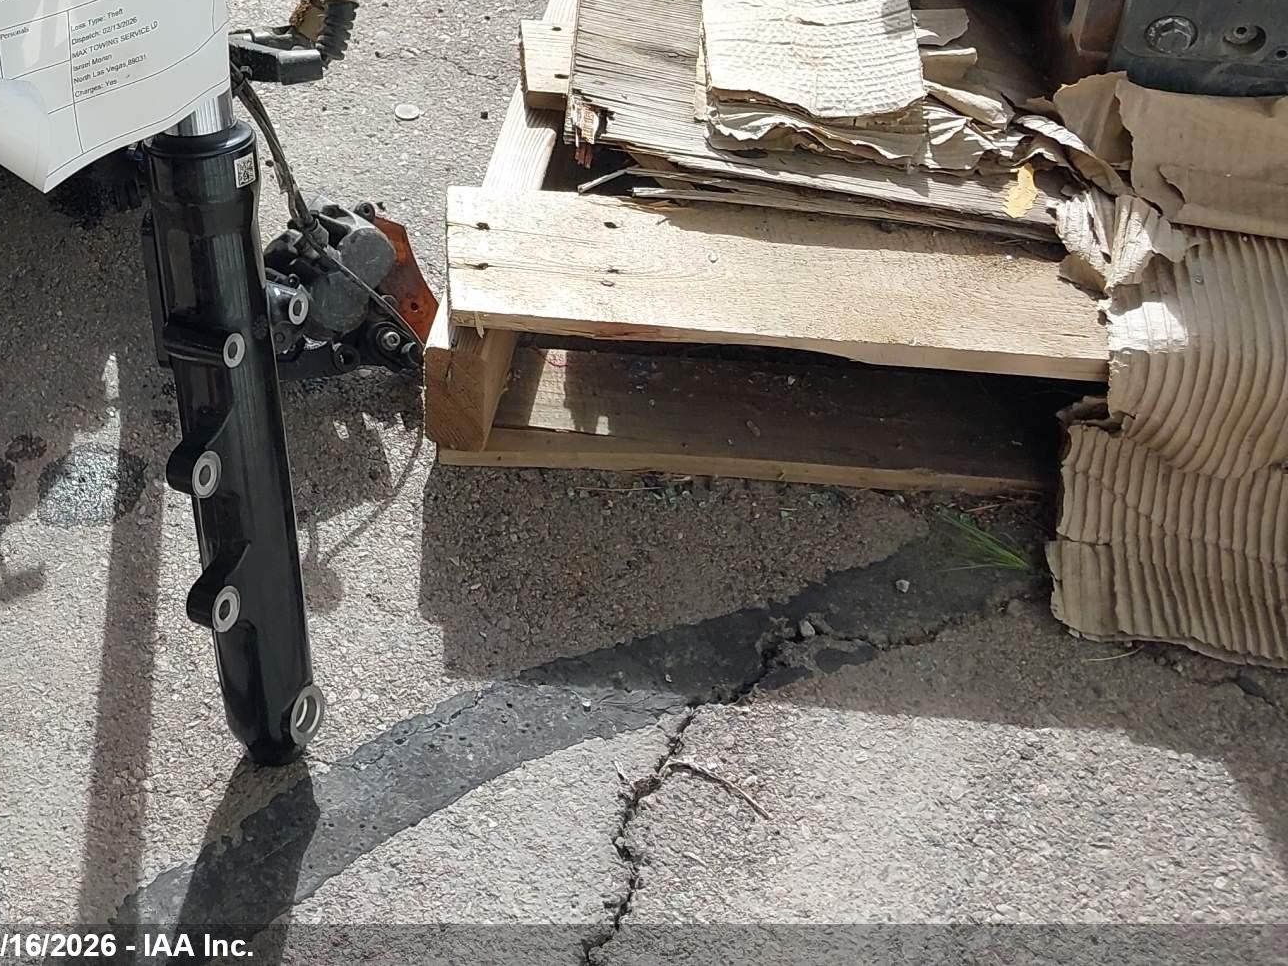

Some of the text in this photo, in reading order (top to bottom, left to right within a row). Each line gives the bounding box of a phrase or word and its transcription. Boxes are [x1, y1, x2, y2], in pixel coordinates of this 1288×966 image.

[71, 8, 123, 32] Loss Type: Theft
[72, 17, 138, 45] Dispatch: 02/13/2026
[72, 48, 87, 58] MAX
[89, 37, 118, 53] TOWING
[120, 25, 150, 42] SERVICE
[73, 60, 91, 71] Israel
[73, 74, 91, 84] North
[92, 69, 105, 78] Las
[74, 78, 117, 98] Charges: Yes
